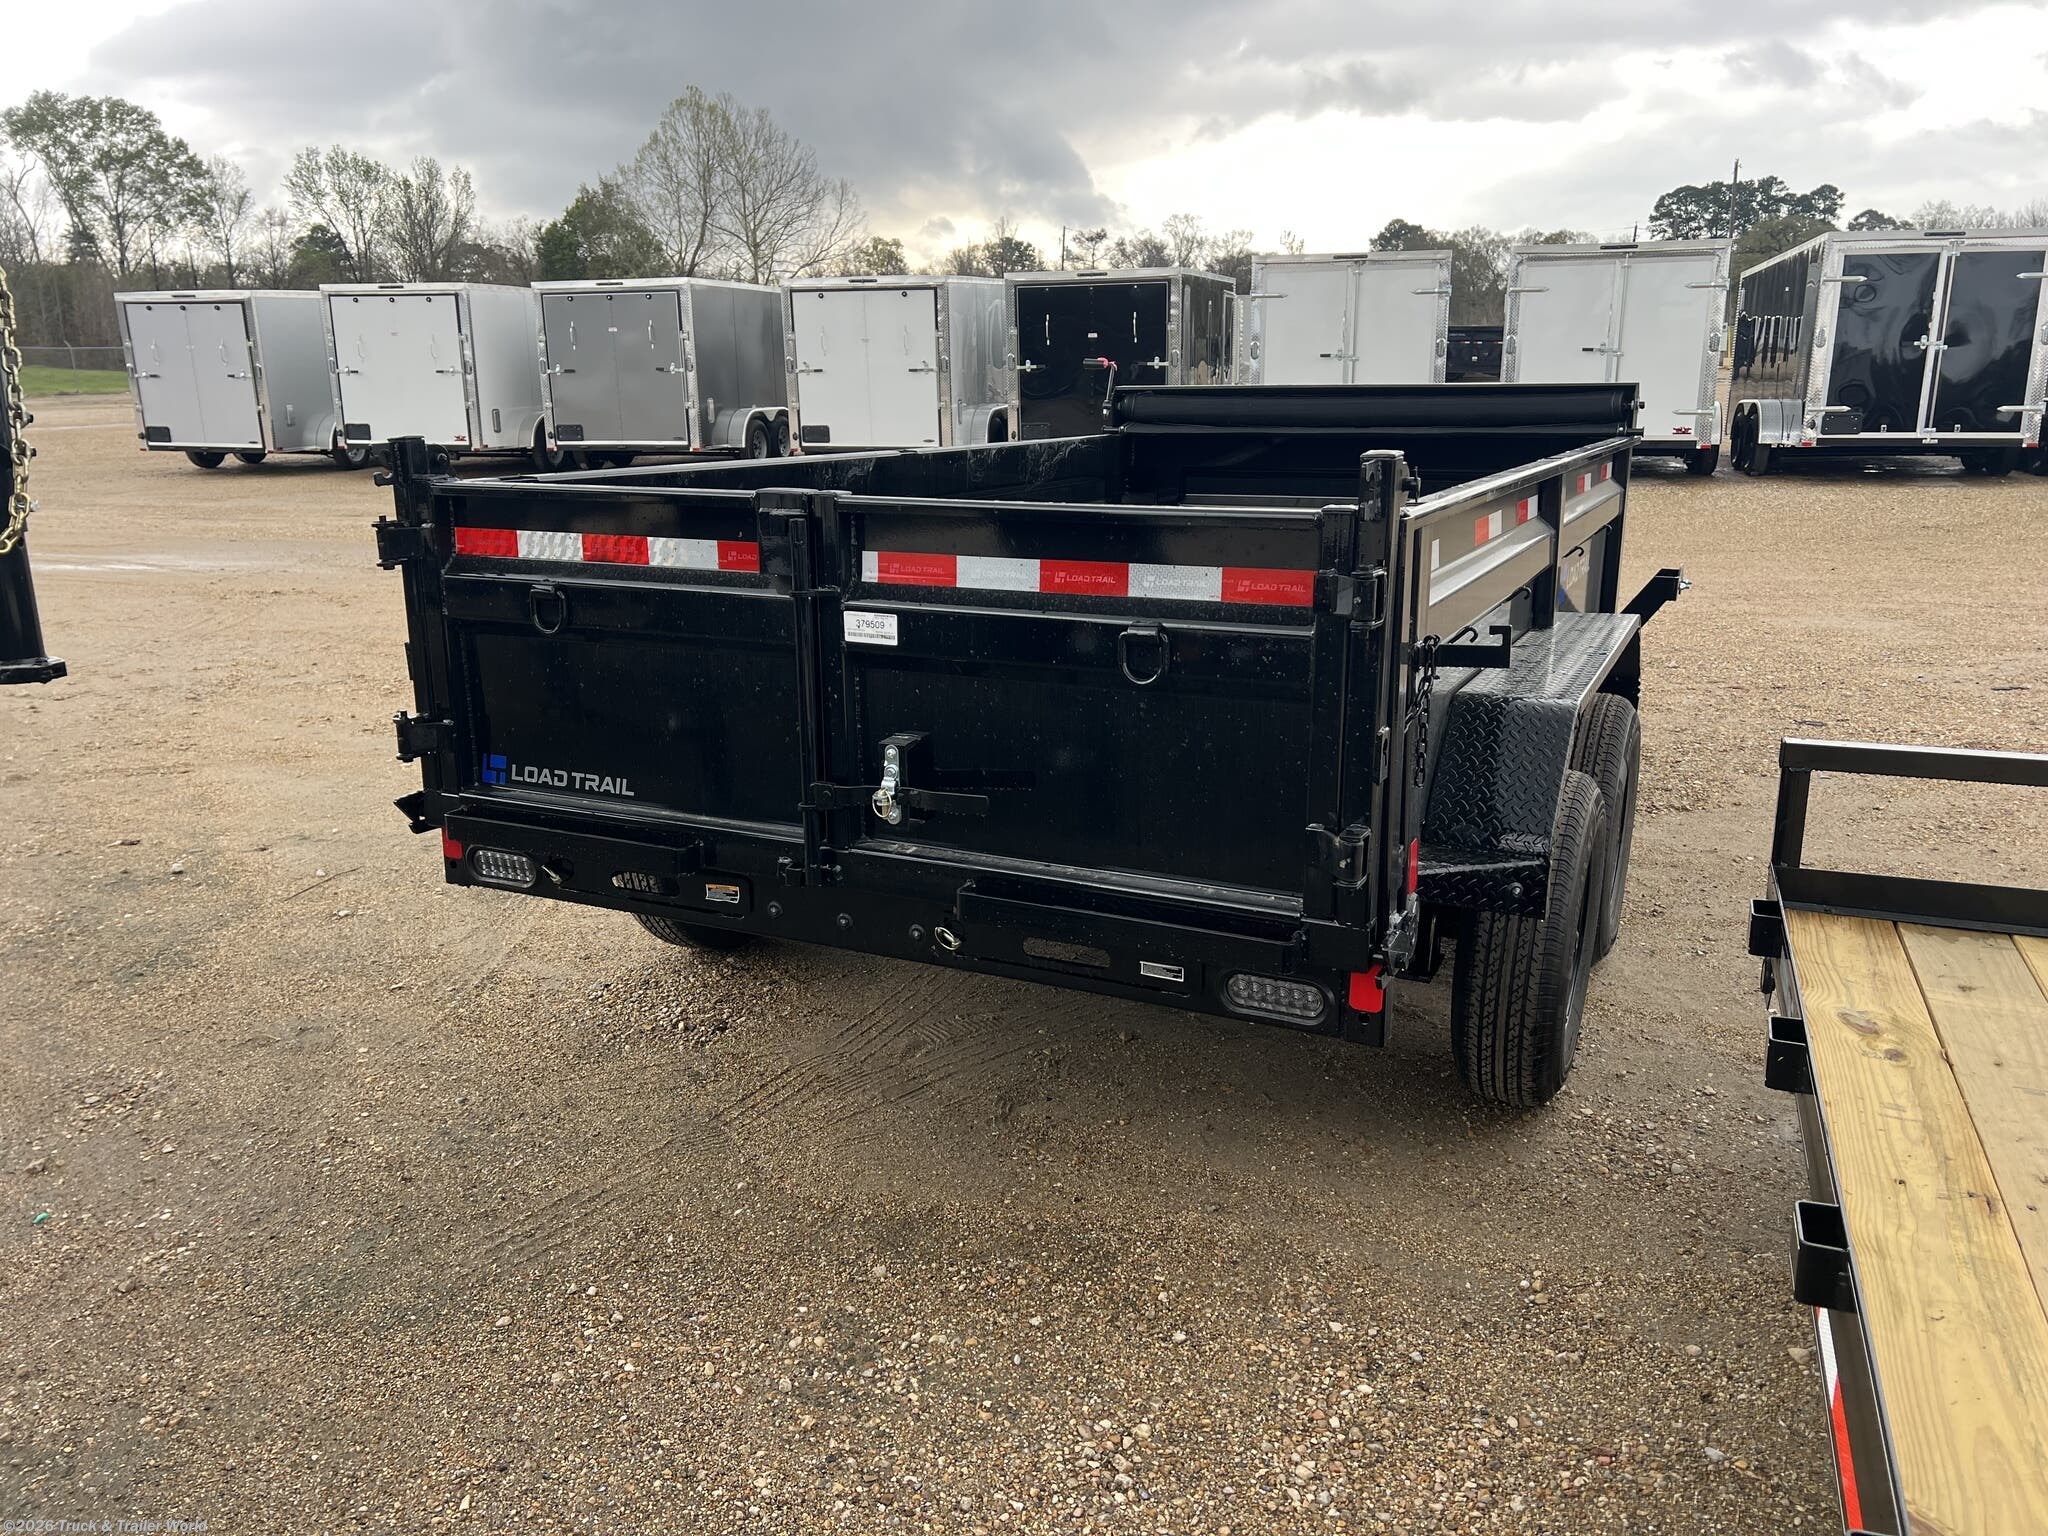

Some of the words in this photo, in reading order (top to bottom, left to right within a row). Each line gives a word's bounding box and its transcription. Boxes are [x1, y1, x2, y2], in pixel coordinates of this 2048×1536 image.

[1066, 574, 1090, 583] LOAD
[1091, 575, 1116, 584] TRAIL
[1250, 583, 1277, 591] LOAD
[1278, 584, 1306, 593] TRAIL
[855, 618, 885, 629] 379509
[511, 764, 568, 787] LOAD
[571, 771, 635, 796] TRAIL
